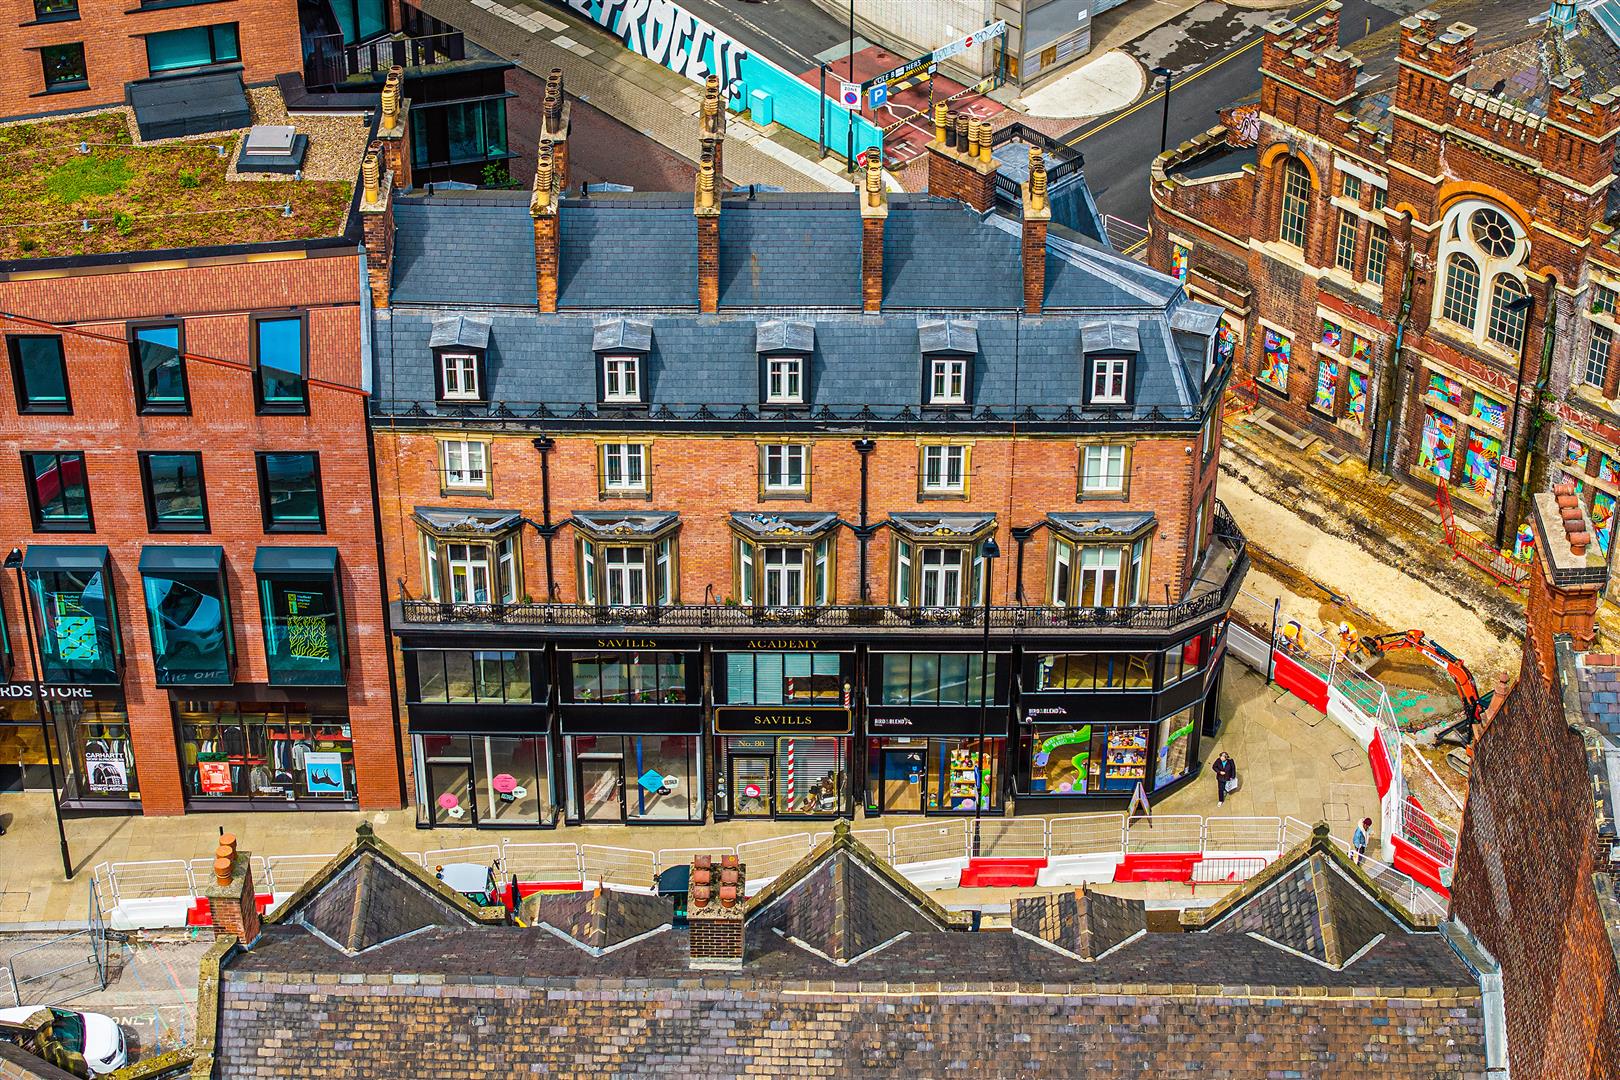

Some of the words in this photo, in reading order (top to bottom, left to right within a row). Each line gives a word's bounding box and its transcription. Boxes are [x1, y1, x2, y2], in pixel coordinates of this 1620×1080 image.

[891, 60, 921, 78] BHERS
[874, 89, 884, 102] P
[1455, 356, 1517, 393] ARMY
[598, 639, 657, 648] SAVILLS
[747, 640, 819, 649] ACADEMY
[754, 715, 812, 725] SAVILLS
[111, 1016, 156, 1026] ONLY
